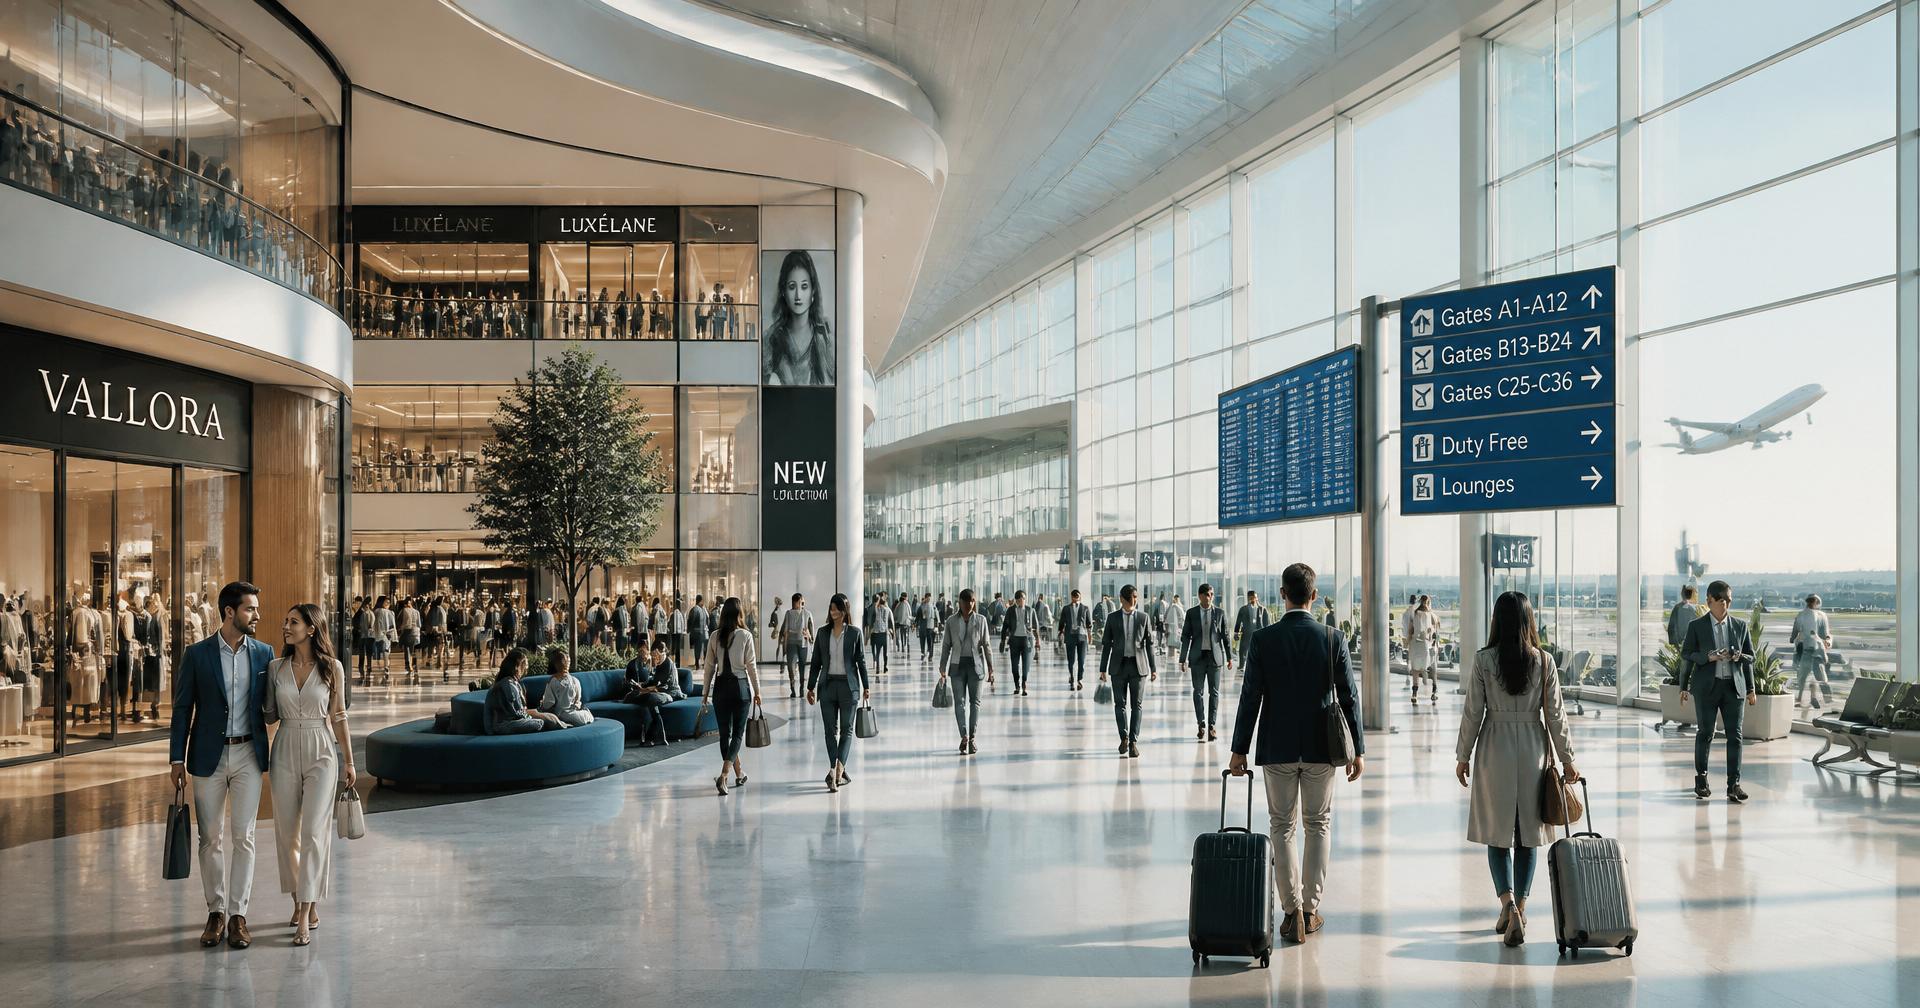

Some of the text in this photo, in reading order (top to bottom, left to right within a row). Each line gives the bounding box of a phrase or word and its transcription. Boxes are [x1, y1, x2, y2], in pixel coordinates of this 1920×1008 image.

[560, 213, 656, 233] LUXÉLANE
[1441, 291, 1568, 327] Gates A1-A12
[1441, 331, 1573, 365] Gates B13-B24
[1441, 371, 1573, 404] Gates C25-C36
[38, 368, 225, 440] VALLORA
[1442, 432, 1528, 458] Duty Free
[774, 460, 827, 485] NEW
[1442, 477, 1515, 499] Lounges
